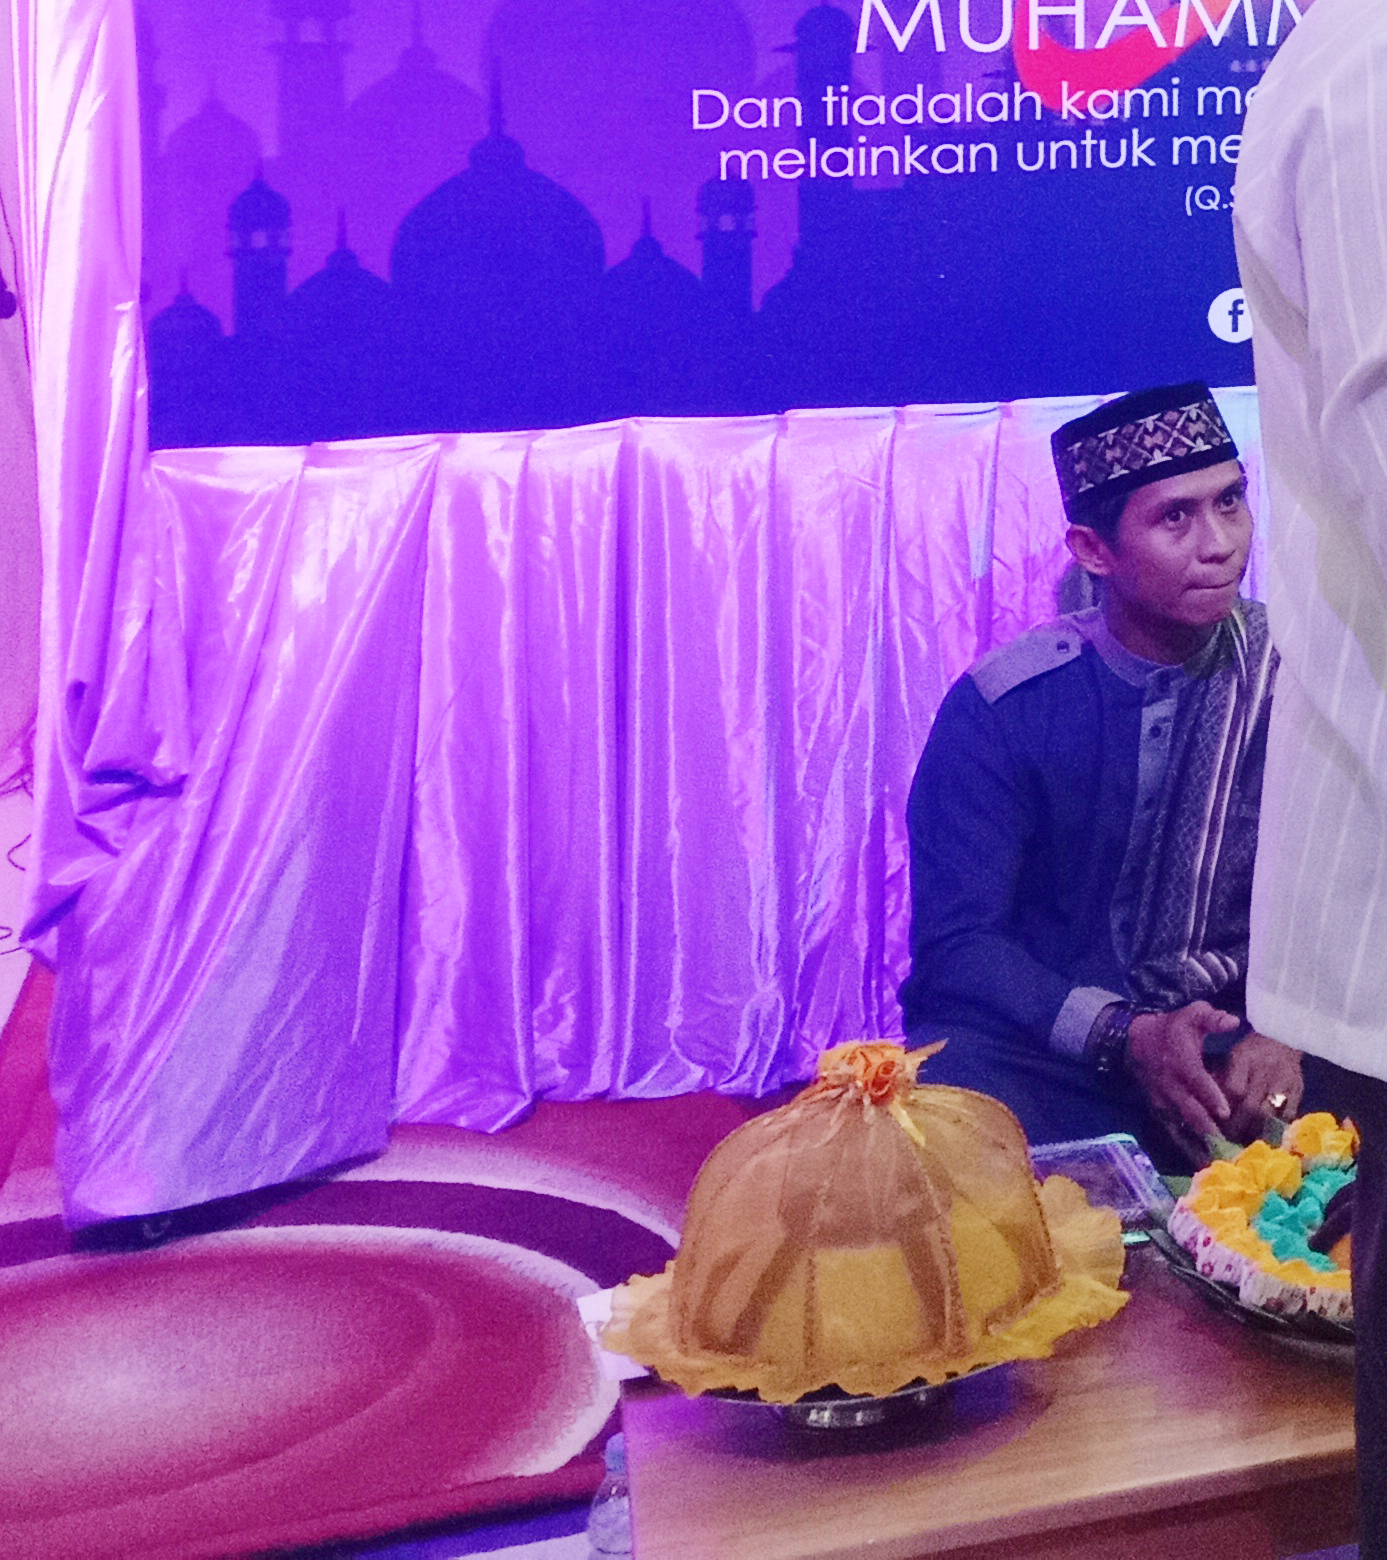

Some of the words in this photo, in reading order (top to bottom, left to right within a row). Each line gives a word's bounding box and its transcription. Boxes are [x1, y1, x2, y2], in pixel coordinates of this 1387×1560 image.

[692, 89, 803, 130] Dan
[821, 81, 1042, 126] tiadalah
[1061, 76, 1181, 120] kami
[720, 135, 998, 181] melainkan
[1016, 128, 1156, 172] untuk
